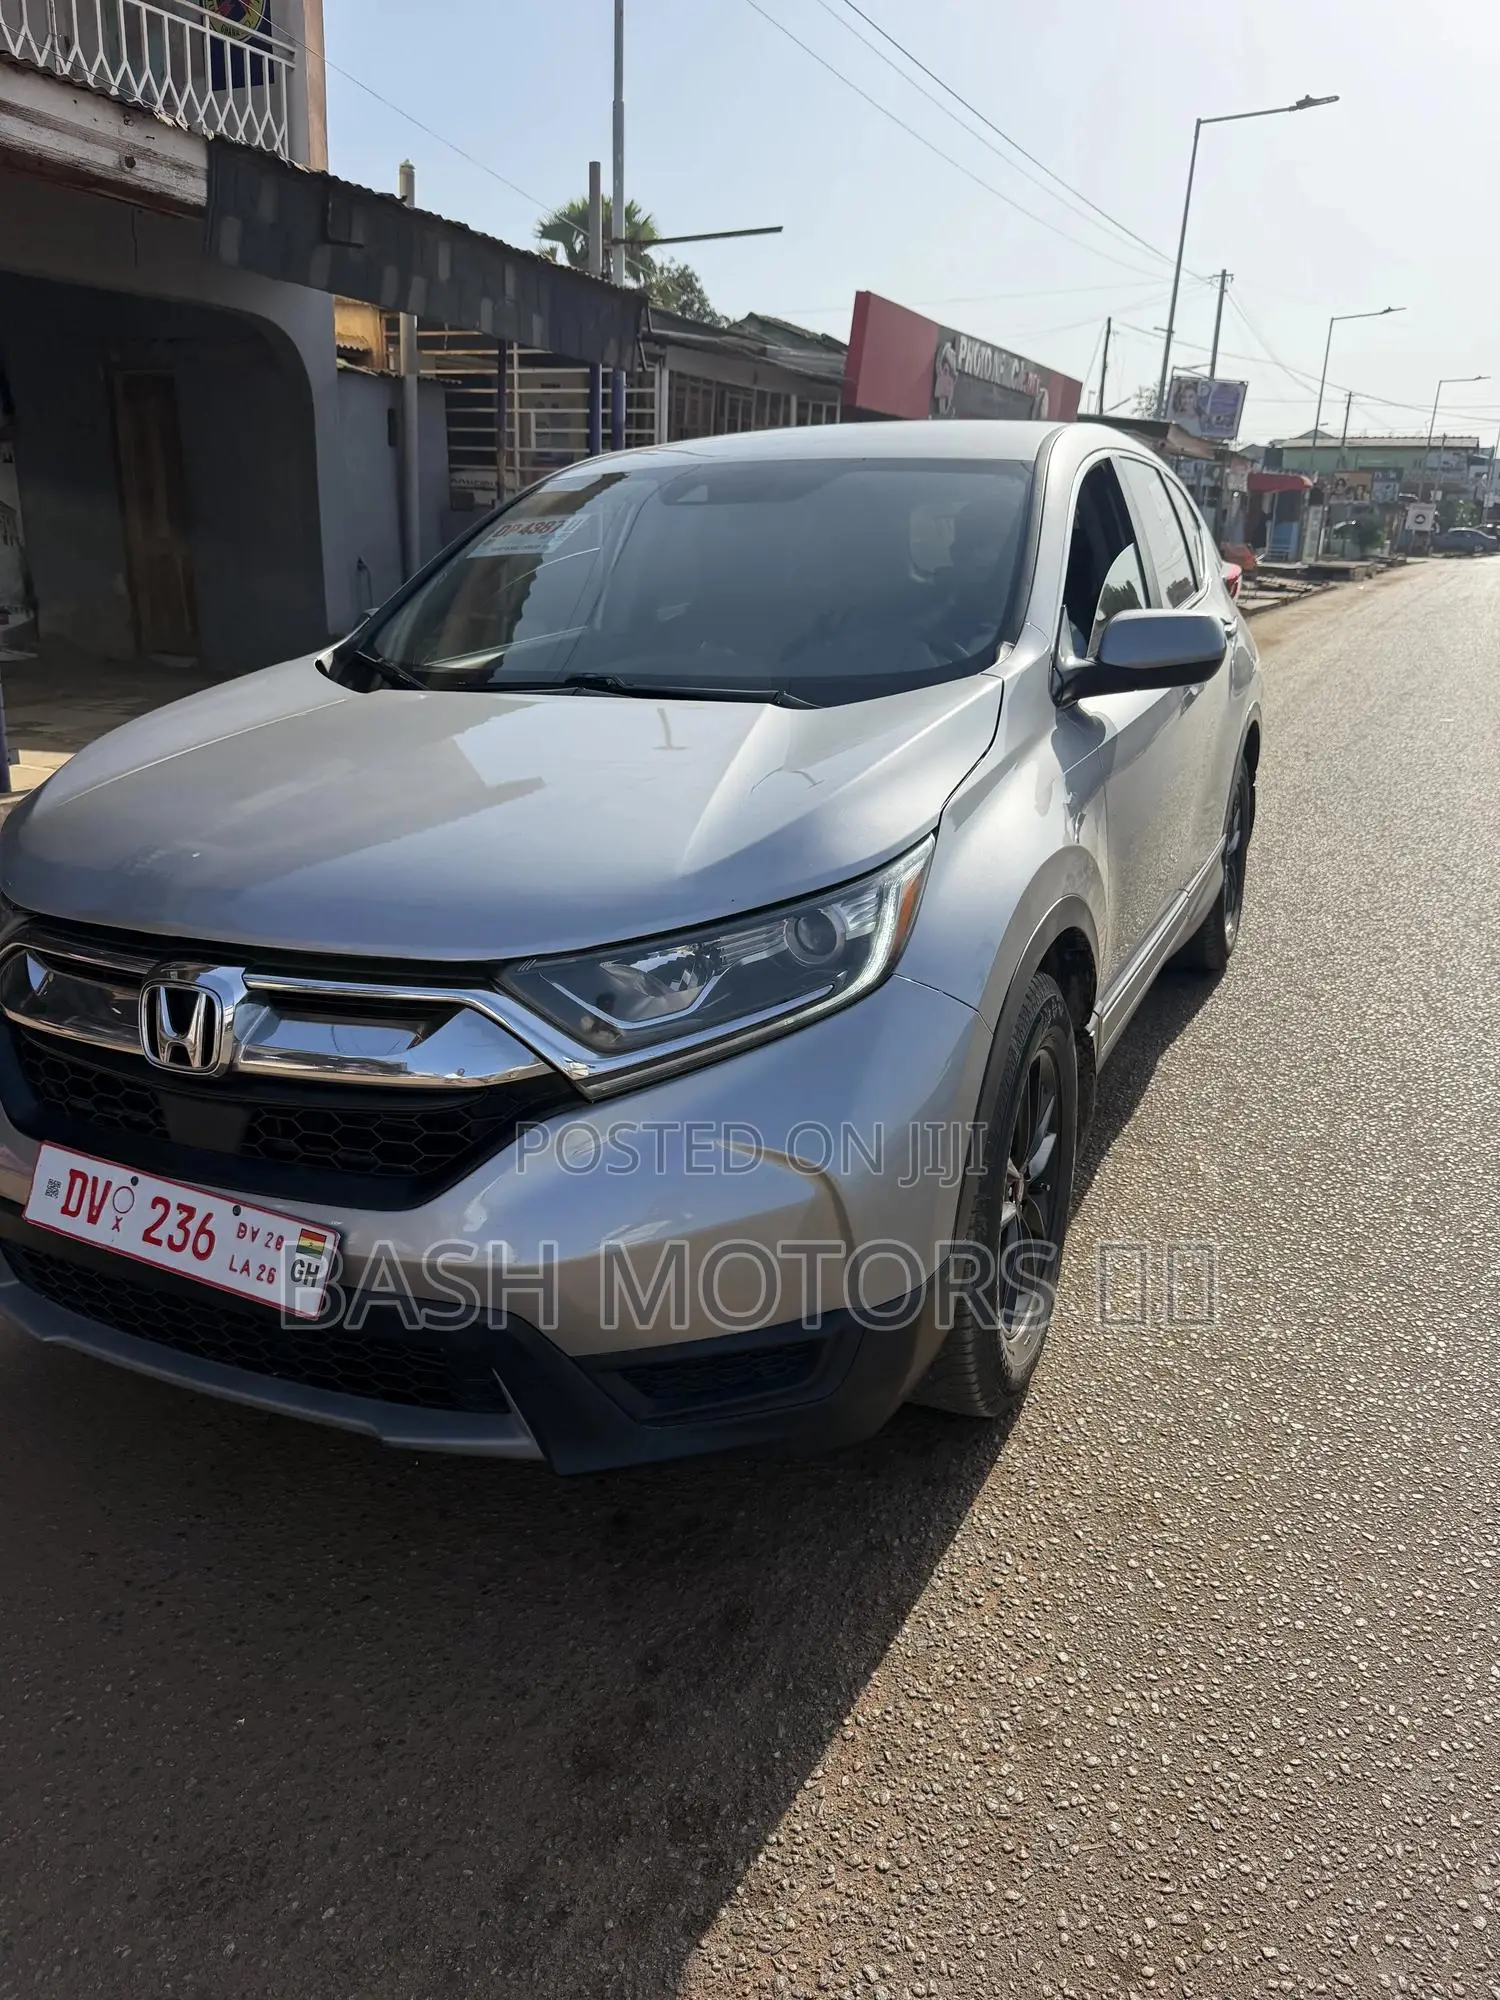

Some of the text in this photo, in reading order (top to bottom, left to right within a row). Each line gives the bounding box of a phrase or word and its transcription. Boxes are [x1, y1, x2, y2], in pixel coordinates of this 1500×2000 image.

[61, 1168, 216, 1261] DV 236
[228, 1254, 277, 1284] LA 26
[290, 1259, 320, 1288] GH
